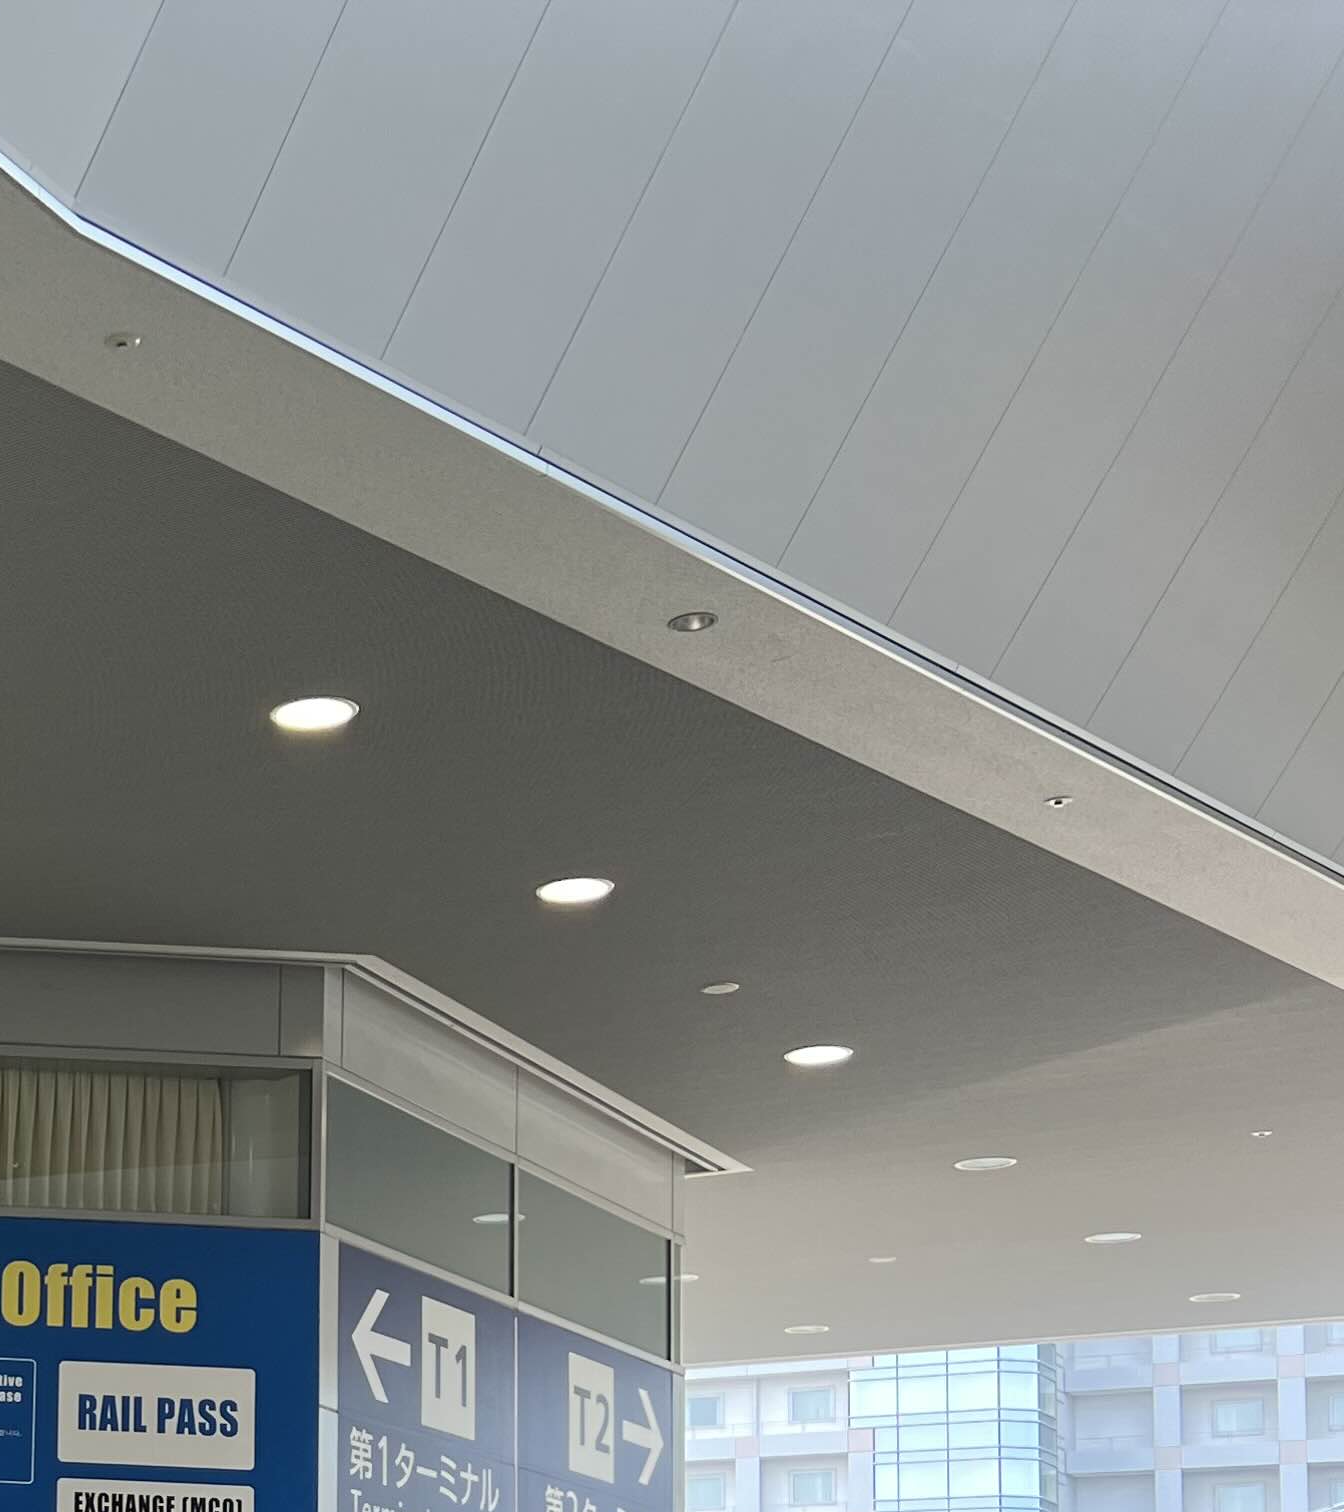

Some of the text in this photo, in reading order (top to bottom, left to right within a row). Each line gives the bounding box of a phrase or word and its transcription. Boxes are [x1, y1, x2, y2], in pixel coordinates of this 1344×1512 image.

[0, 1260, 198, 1333] Office
[428, 1332, 468, 1408] T1
[77, 1393, 239, 1438] RAIL PASS
[574, 1385, 611, 1455] T2
[349, 1426, 499, 1512] 第1ターミナル
